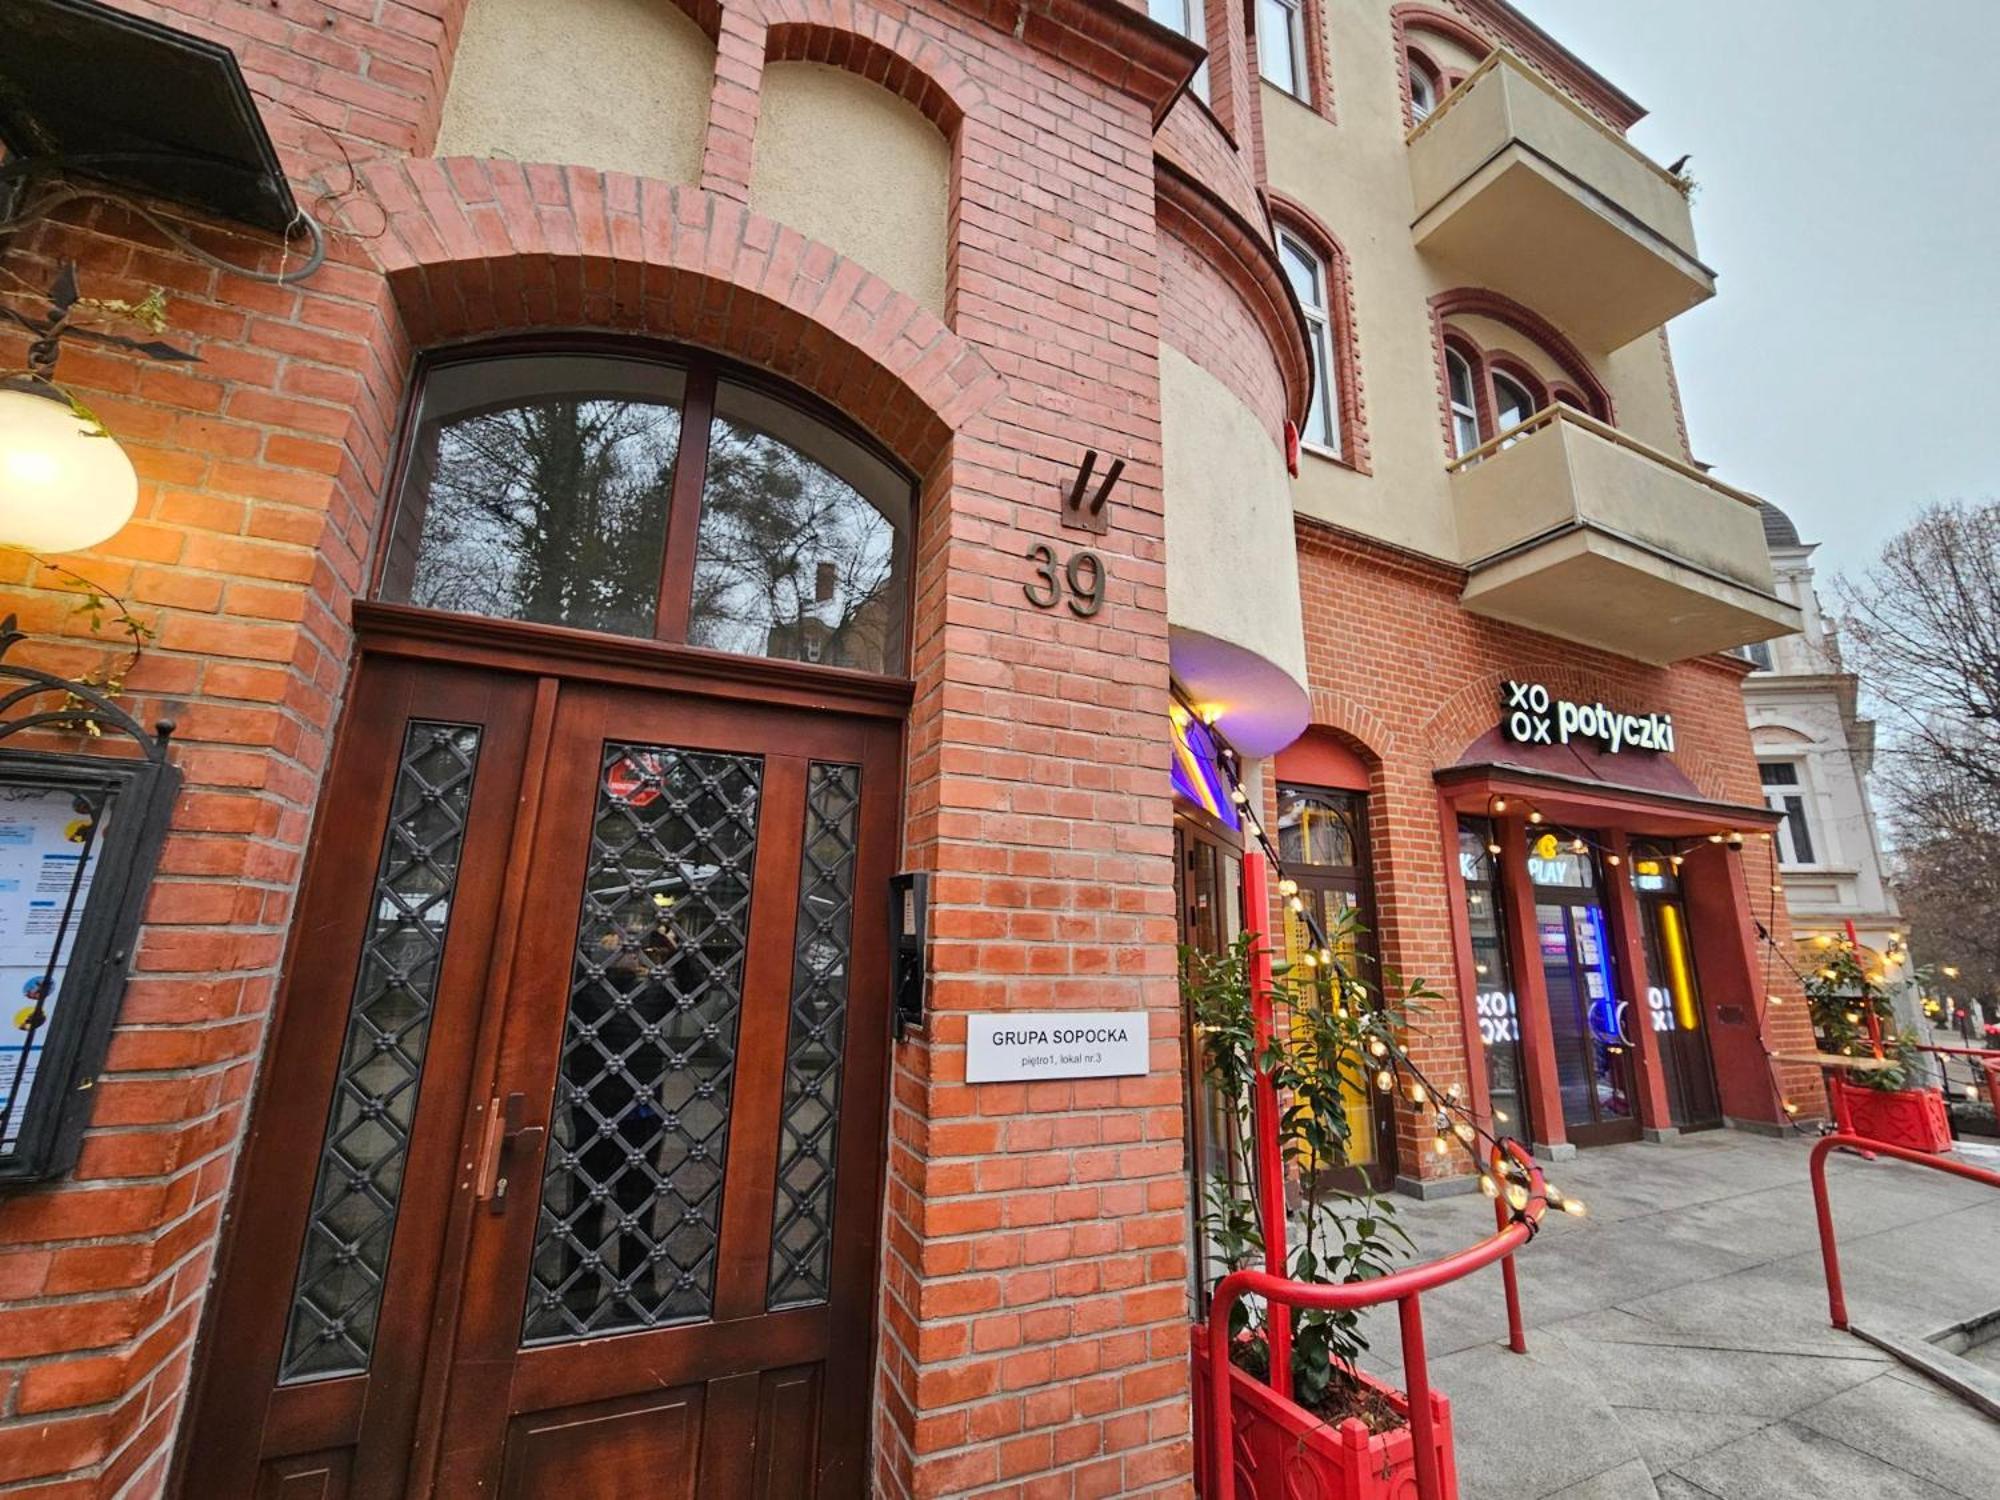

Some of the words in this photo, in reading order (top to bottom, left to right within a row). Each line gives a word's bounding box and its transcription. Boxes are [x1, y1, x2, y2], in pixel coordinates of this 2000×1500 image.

[1023, 543, 1106, 617] 39
[1508, 679, 1550, 714] XO
[1510, 711, 1552, 745] OX
[1557, 700, 1676, 753] potyczki
[1528, 857, 1568, 884] PLAY
[992, 1030, 1049, 1046] GRUPA
[1053, 1028, 1129, 1044] SOPOCKA
[1060, 1053, 1082, 1065] lokal
